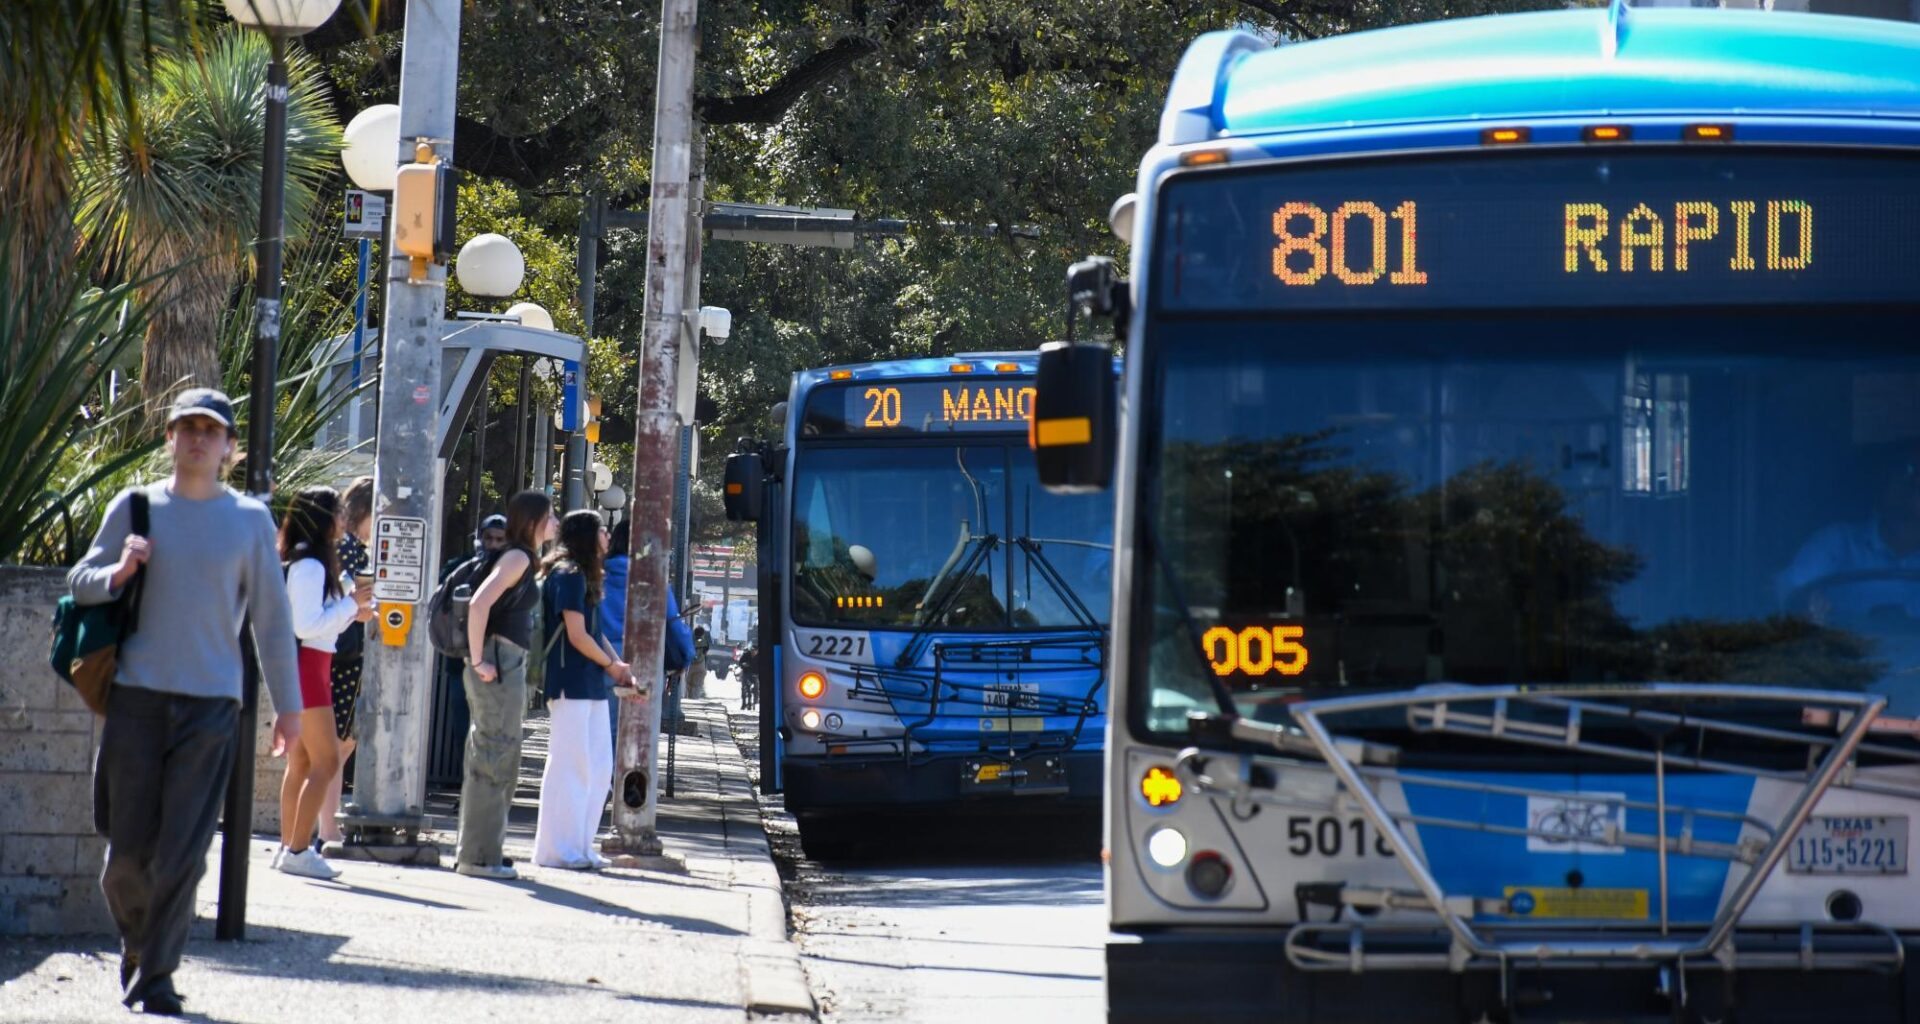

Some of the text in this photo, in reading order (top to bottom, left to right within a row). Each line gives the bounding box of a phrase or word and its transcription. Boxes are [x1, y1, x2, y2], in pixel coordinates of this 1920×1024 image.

[1272, 200, 1812, 285] 801 RAPID
[864, 387, 901, 427] 20
[809, 635, 866, 657] 2221
[1202, 626, 1308, 676] 005
[1822, 816, 1874, 831] TEXAS
